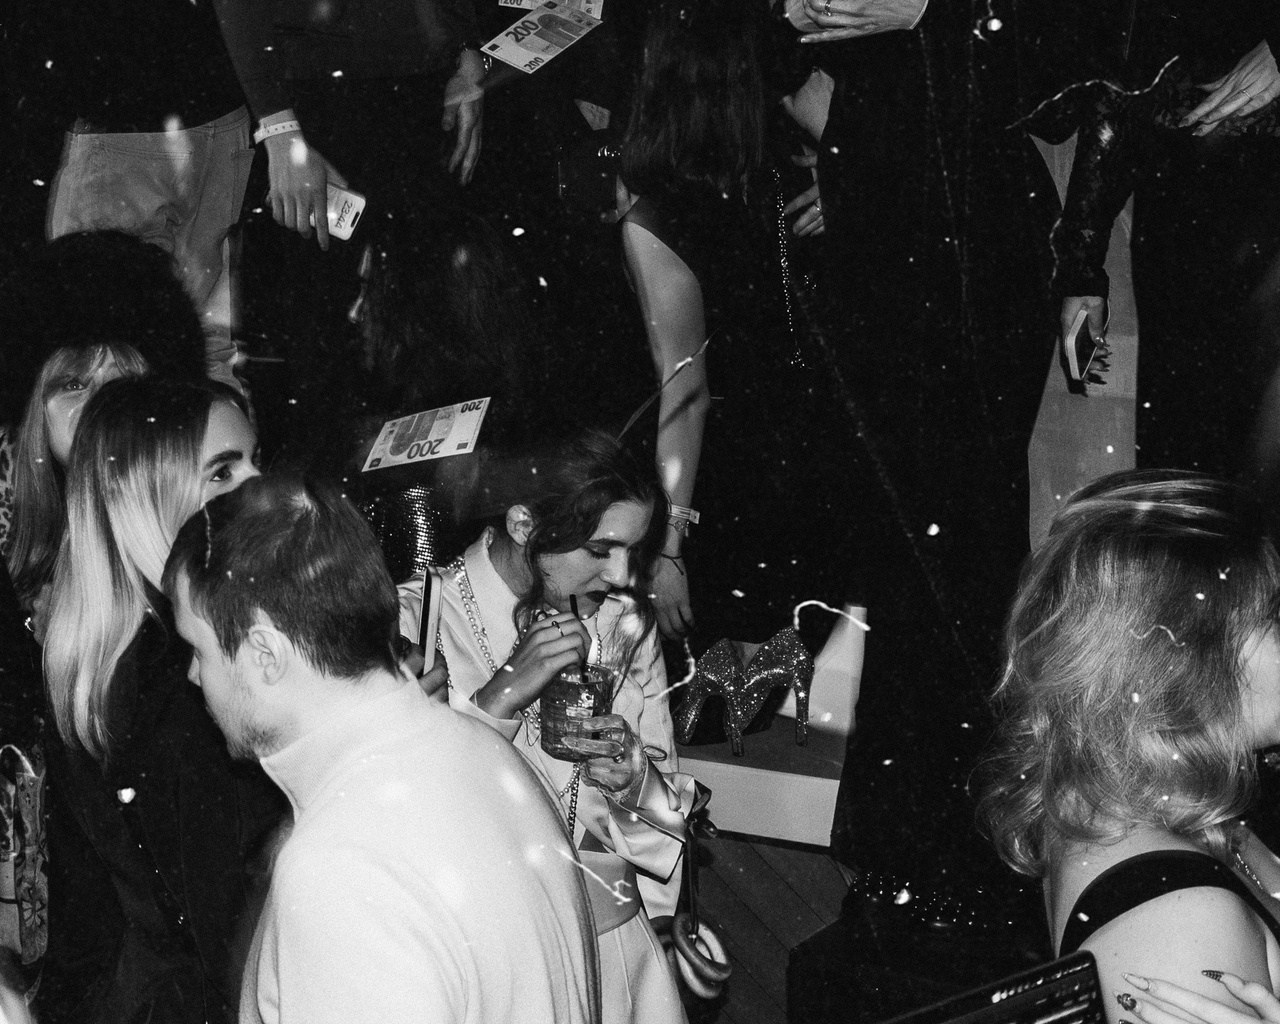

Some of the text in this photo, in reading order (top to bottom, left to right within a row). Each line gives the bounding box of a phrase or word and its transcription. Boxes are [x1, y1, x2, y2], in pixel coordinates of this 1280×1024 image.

[505, 20, 540, 43] 200
[524, 57, 545, 71] 200
[460, 400, 484, 414] 200
[407, 438, 445, 459] 200
